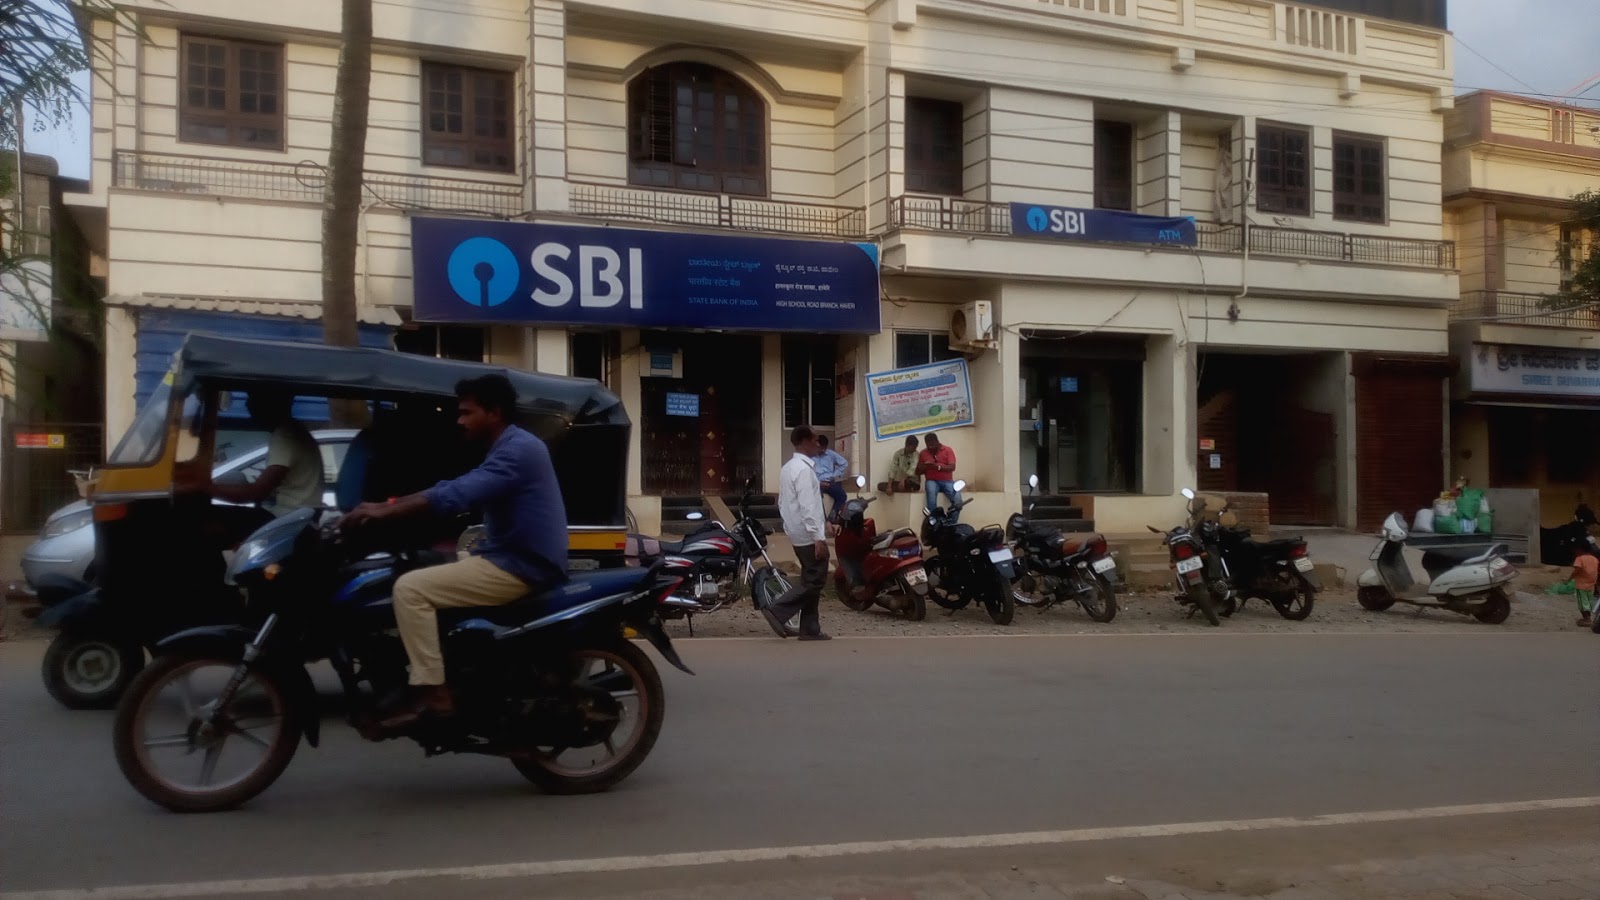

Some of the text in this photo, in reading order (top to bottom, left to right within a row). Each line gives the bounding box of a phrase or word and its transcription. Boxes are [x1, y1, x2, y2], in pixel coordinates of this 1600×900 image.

[1050, 209, 1086, 234] SBI
[1158, 229, 1181, 241] ATM
[531, 242, 643, 309] SBI
[1521, 374, 1553, 386] SHREE
